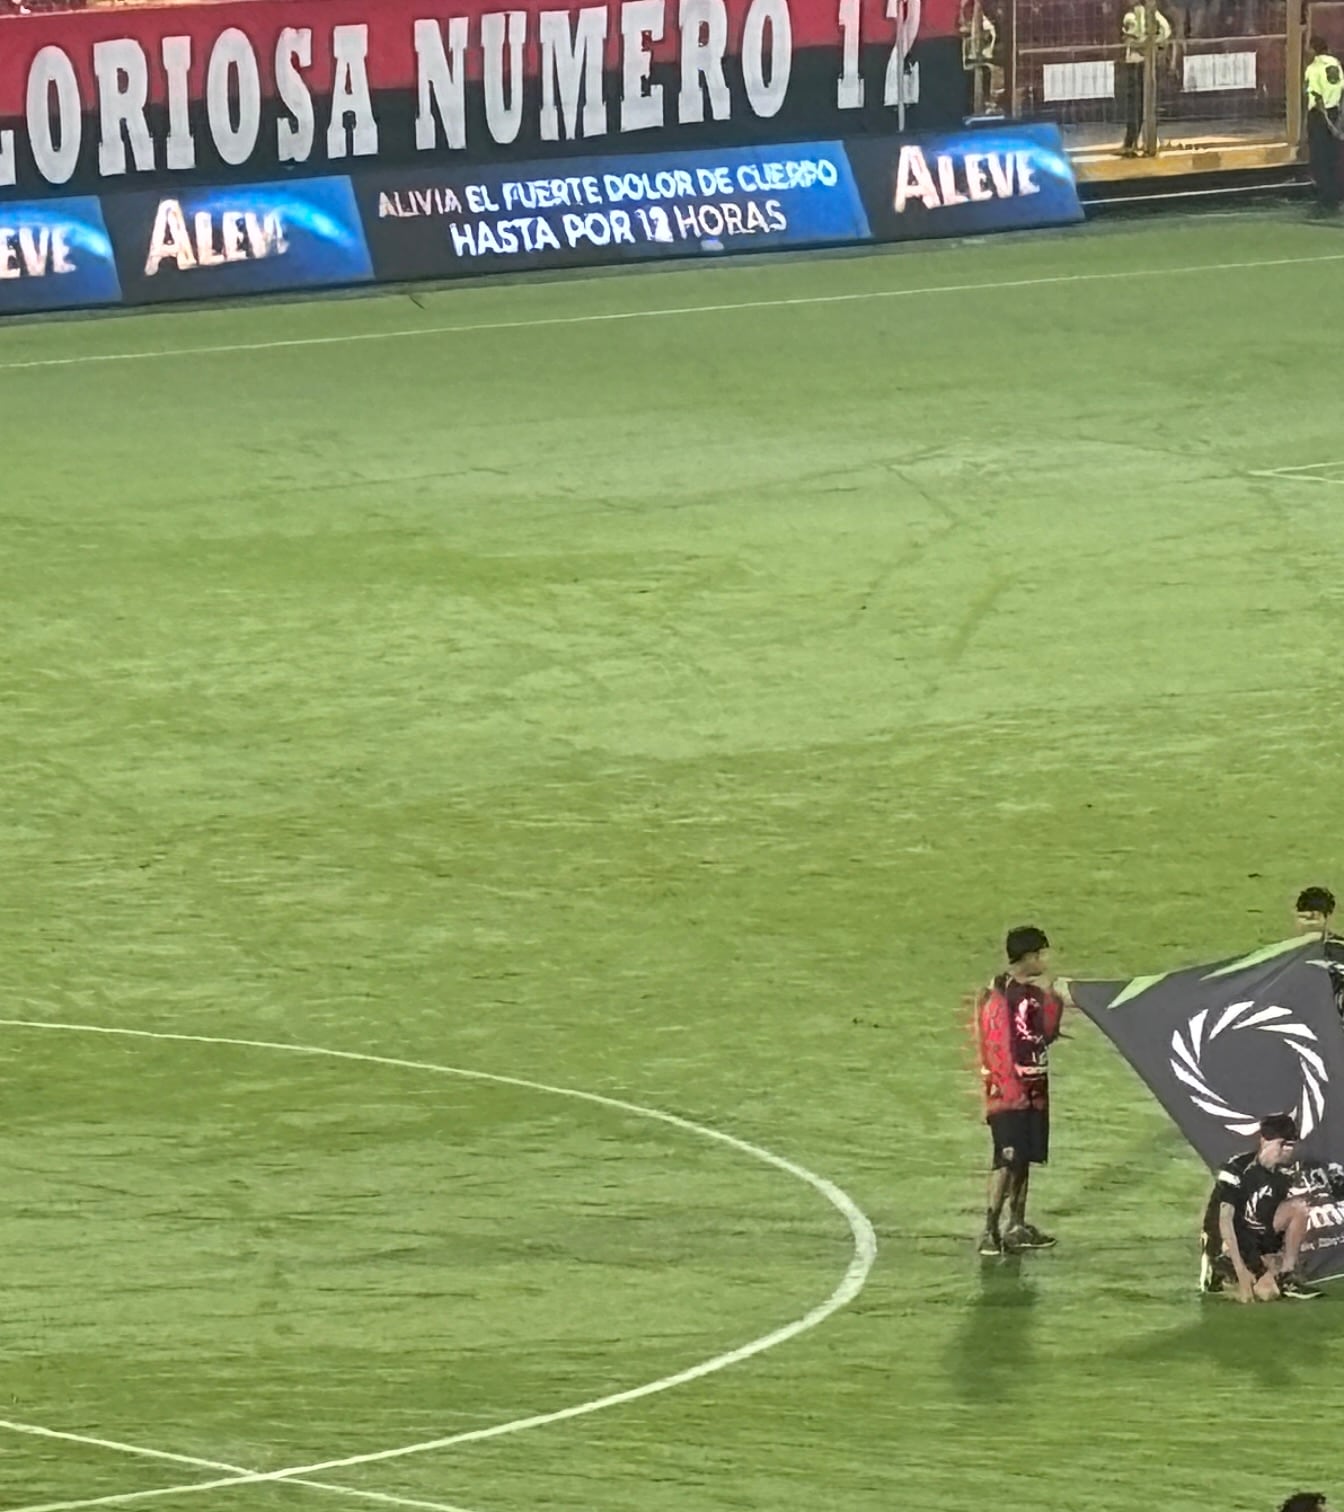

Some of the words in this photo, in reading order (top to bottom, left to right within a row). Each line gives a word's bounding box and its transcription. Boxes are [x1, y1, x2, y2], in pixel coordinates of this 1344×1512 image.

[414, 0, 793, 150] NUMERO
[837, 0, 920, 109] 12
[379, 187, 462, 218] ALIVIA
[466, 184, 499, 213] EL
[503, 175, 602, 211] FUERTE
[604, 169, 696, 203] DOLOR
[696, 166, 734, 196] DE
[737, 158, 838, 192] CUERPO
[894, 145, 1041, 213] ALEVE
[449, 216, 560, 257] HASTA
[563, 208, 636, 248] POR
[635, 206, 673, 243] 12
[673, 199, 787, 239] HORAS
